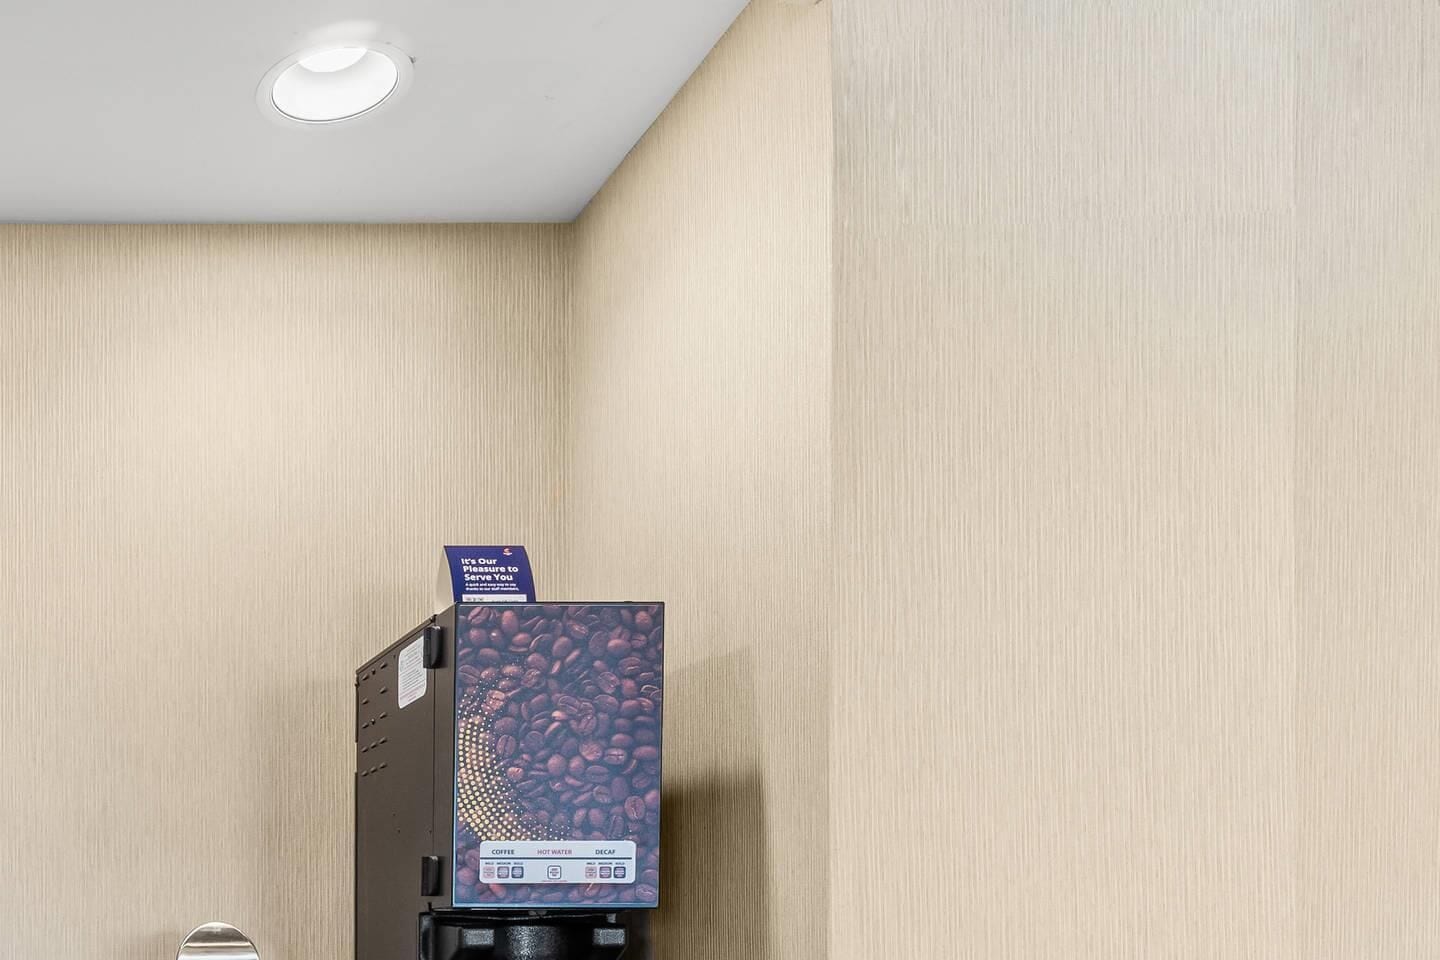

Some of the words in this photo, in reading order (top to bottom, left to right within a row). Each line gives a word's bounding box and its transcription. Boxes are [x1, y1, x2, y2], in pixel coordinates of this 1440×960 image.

[463, 565, 506, 573] Pleasure
[464, 573, 492, 581] Serve
[493, 573, 513, 581] You
